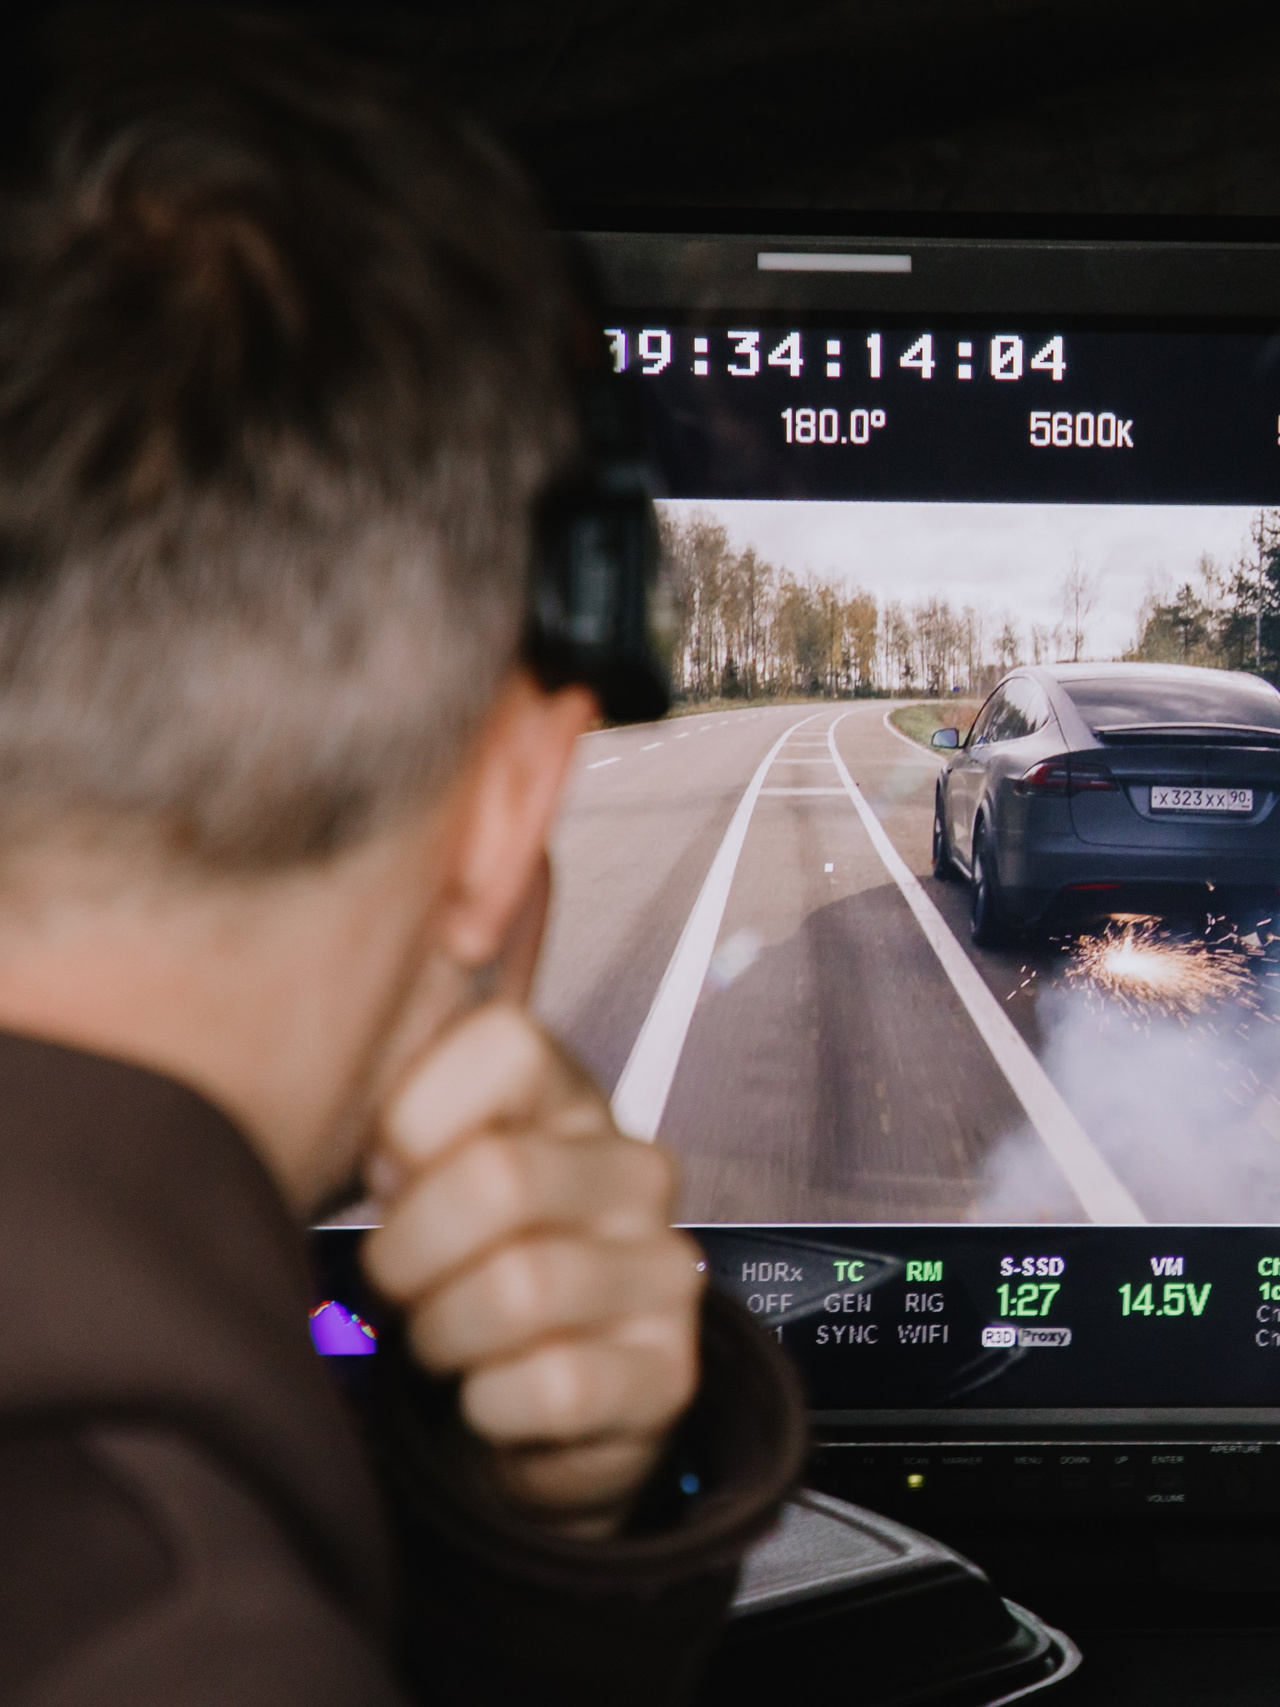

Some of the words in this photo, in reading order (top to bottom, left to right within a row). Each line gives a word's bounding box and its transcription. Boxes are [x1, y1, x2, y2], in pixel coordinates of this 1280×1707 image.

[1029, 410, 1134, 449] 5600K
[832, 1260, 866, 1283] TC
[905, 1260, 943, 1282] RM
[999, 1256, 1065, 1277] S-SSD
[1149, 1256, 1185, 1277] VM
[746, 1293, 794, 1314] OFF
[823, 1292, 872, 1314] GEN
[904, 1292, 945, 1313] RIG
[996, 1283, 1061, 1317] 1:27
[1118, 1283, 1212, 1317] 14.5V
[815, 1324, 879, 1345] SYNC
[897, 1324, 949, 1344] WIFI
[1022, 1329, 1068, 1346] Proxy
[1150, 1455, 1185, 1465] ENTER
